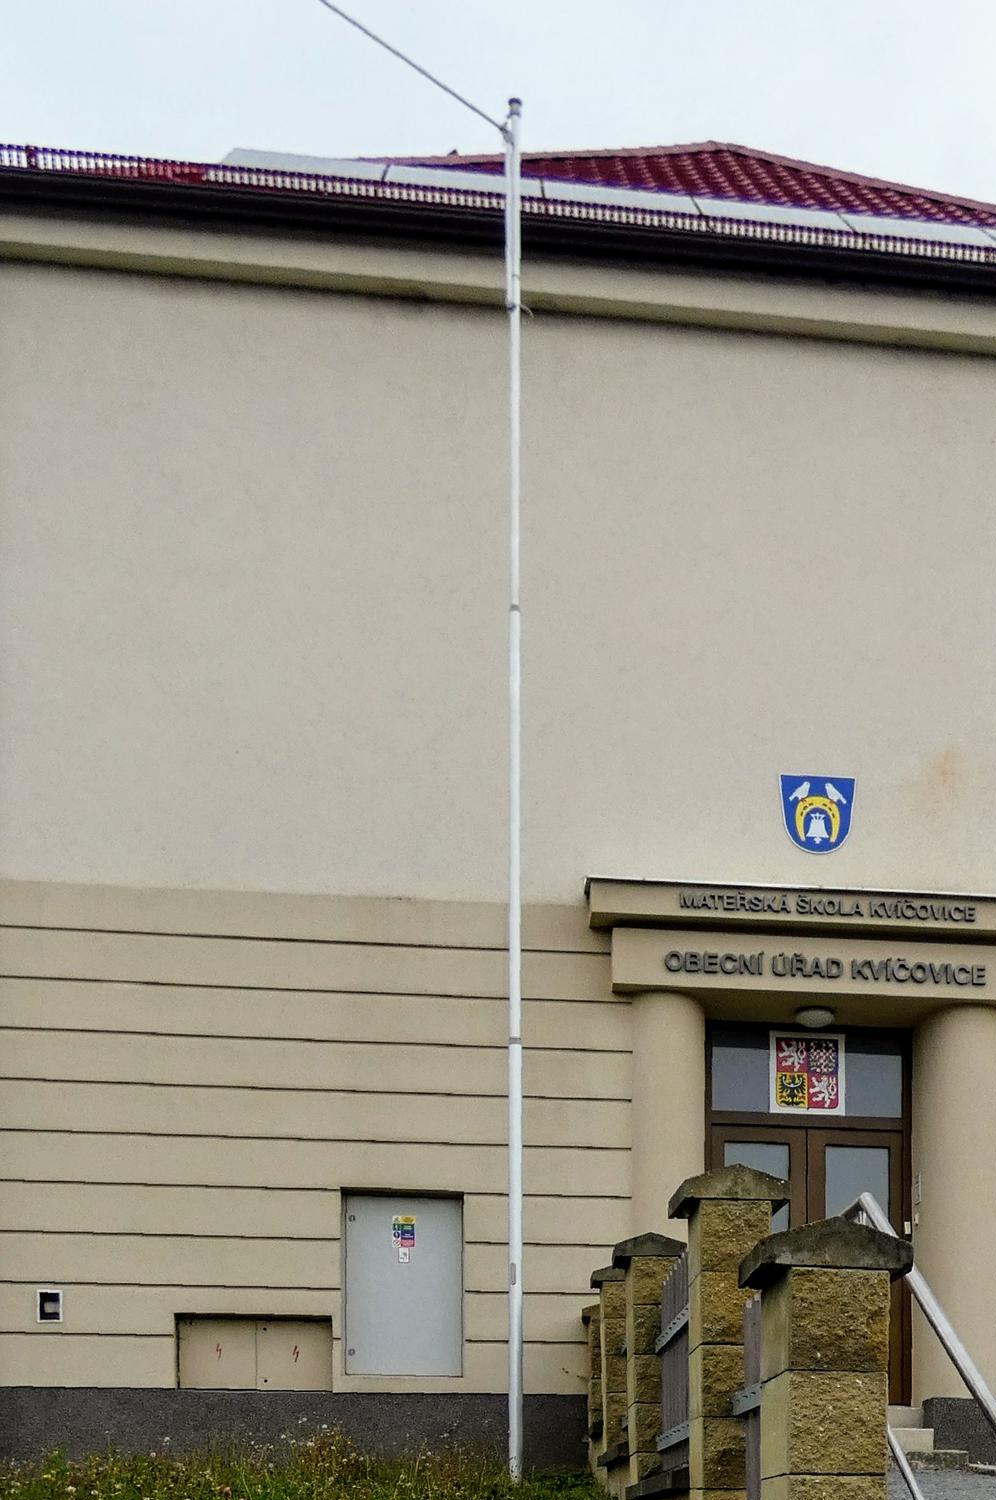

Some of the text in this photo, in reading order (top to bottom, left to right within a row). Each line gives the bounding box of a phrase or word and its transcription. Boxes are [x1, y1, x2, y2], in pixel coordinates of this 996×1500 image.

[679, 891, 977, 922] MATEŘSKÁ ŠKOLA KVÍČOVICE
[664, 950, 987, 986] OBECNÍ ÚŘAD KVÍČOVICE
